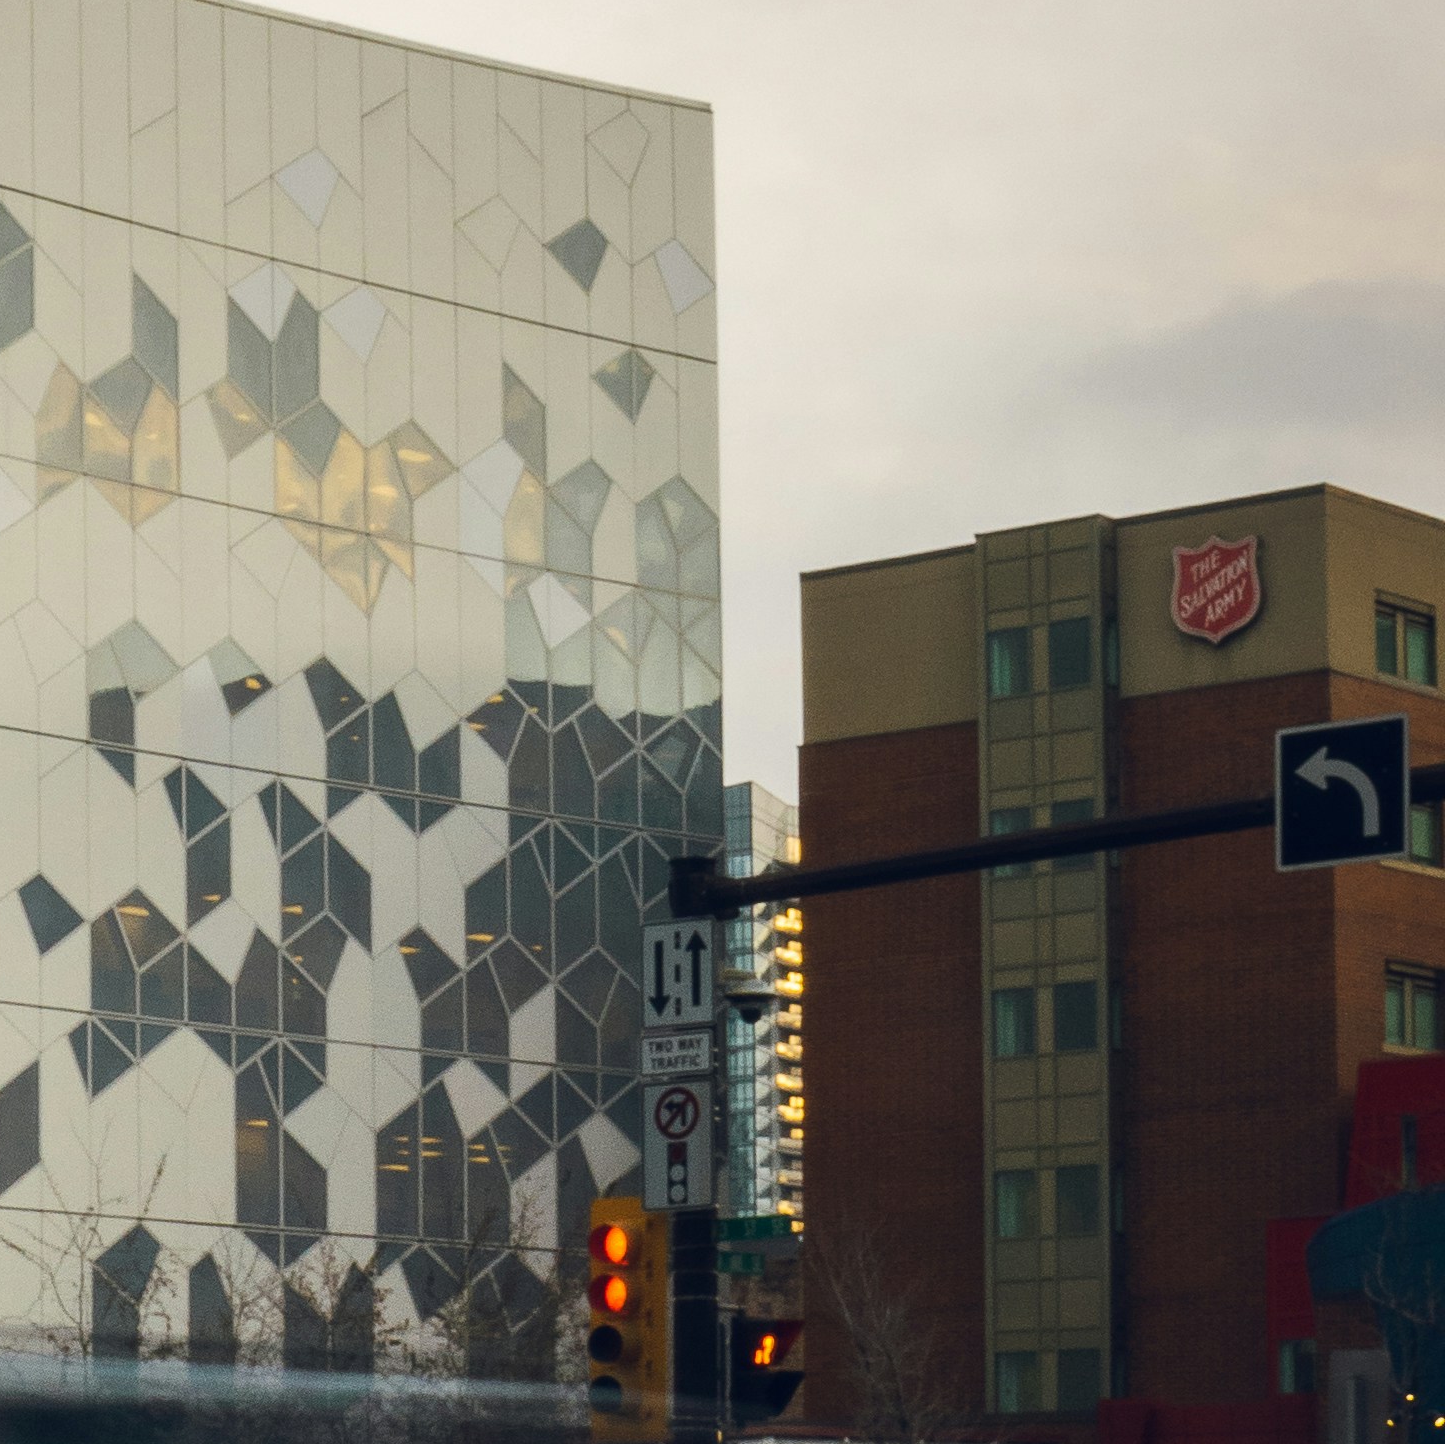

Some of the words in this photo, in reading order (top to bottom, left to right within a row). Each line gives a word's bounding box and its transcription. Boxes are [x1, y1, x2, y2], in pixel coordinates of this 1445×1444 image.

[1190, 550, 1220, 583] THE
[1180, 549, 1248, 618] SALVATION
[1205, 578, 1246, 628] ARMY
[649, 1039, 673, 1053] TWO
[678, 1037, 703, 1050] WAY
[651, 1053, 701, 1070] TRAFFIC
